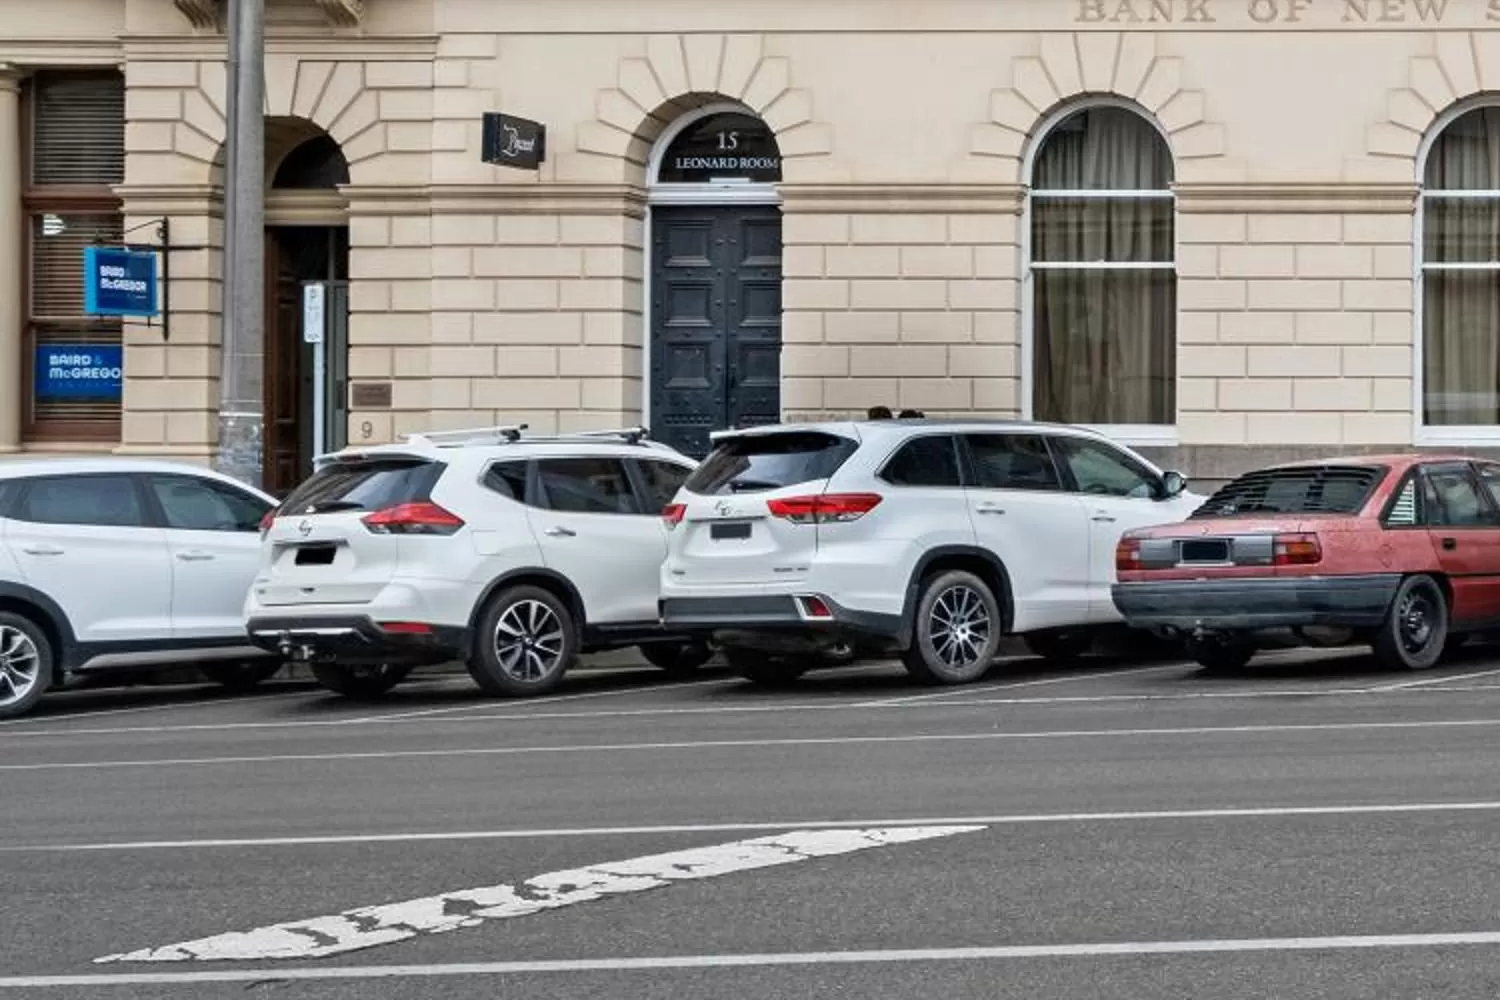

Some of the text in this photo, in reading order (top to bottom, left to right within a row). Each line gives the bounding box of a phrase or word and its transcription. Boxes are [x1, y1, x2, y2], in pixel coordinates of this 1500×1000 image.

[717, 131, 741, 150] 15
[675, 157, 738, 169] LEONARD
[100, 266, 125, 278] BAIRD
[49, 354, 92, 365] BAIRD
[49, 367, 121, 378] McGREGO
[361, 420, 373, 440] 9
